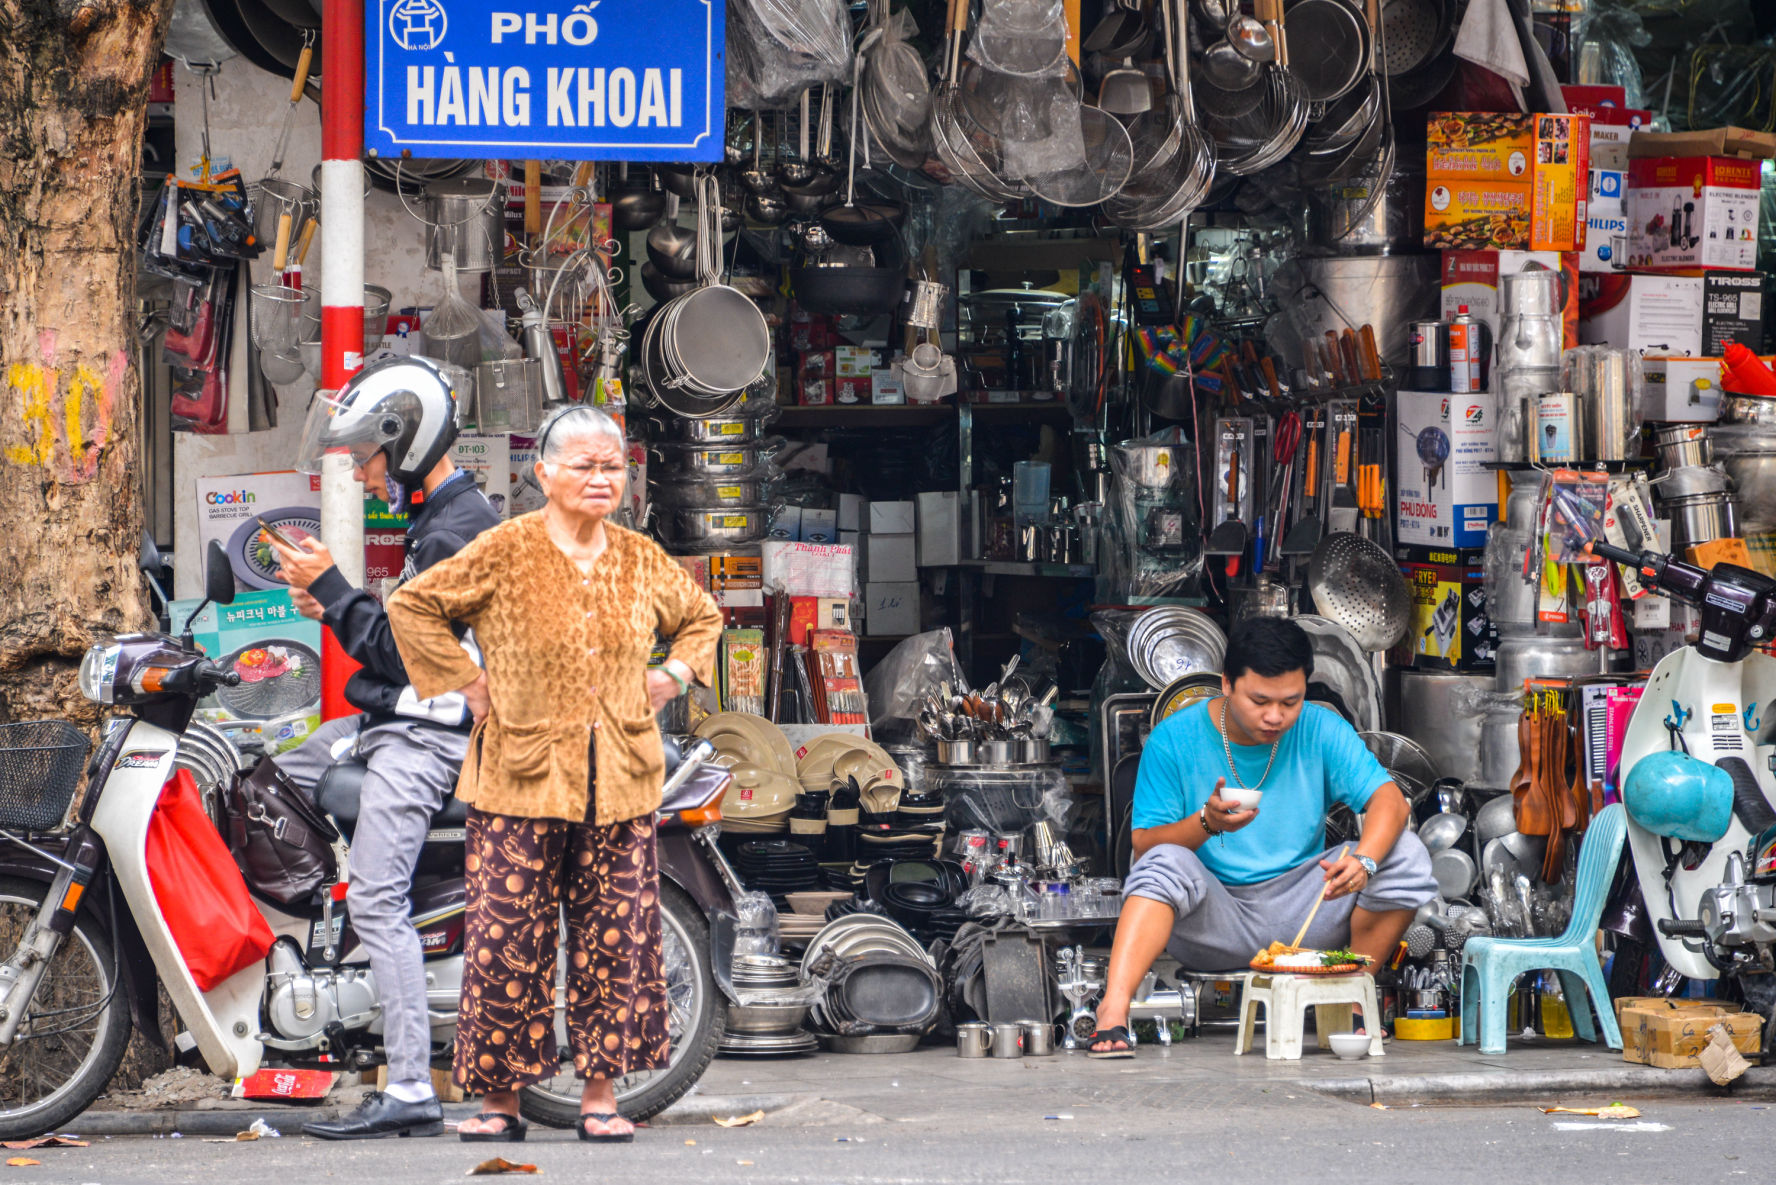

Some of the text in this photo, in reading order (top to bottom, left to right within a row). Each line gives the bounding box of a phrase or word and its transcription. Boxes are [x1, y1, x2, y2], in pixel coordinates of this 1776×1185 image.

[491, 0, 600, 45] PHỐ
[407, 51, 682, 127] HÀNG KHOAI
[1593, 130, 1619, 141] MAKER
[1586, 218, 1626, 232] HILIPS
[1708, 276, 1761, 287] TIROSS
[1708, 293, 1738, 302] TS-965
[509, 453, 536, 462] HILIPS
[206, 489, 256, 505] Cookin
[208, 512, 238, 520] BARBECUE
[1633, 504, 1652, 542] SHARPENER
[365, 534, 405, 545] ROS
[1414, 570, 1437, 584] FRYER
[226, 608, 264, 623] 뉴피크닉
[267, 605, 287, 618] 마블
[289, 604, 299, 615] 구
